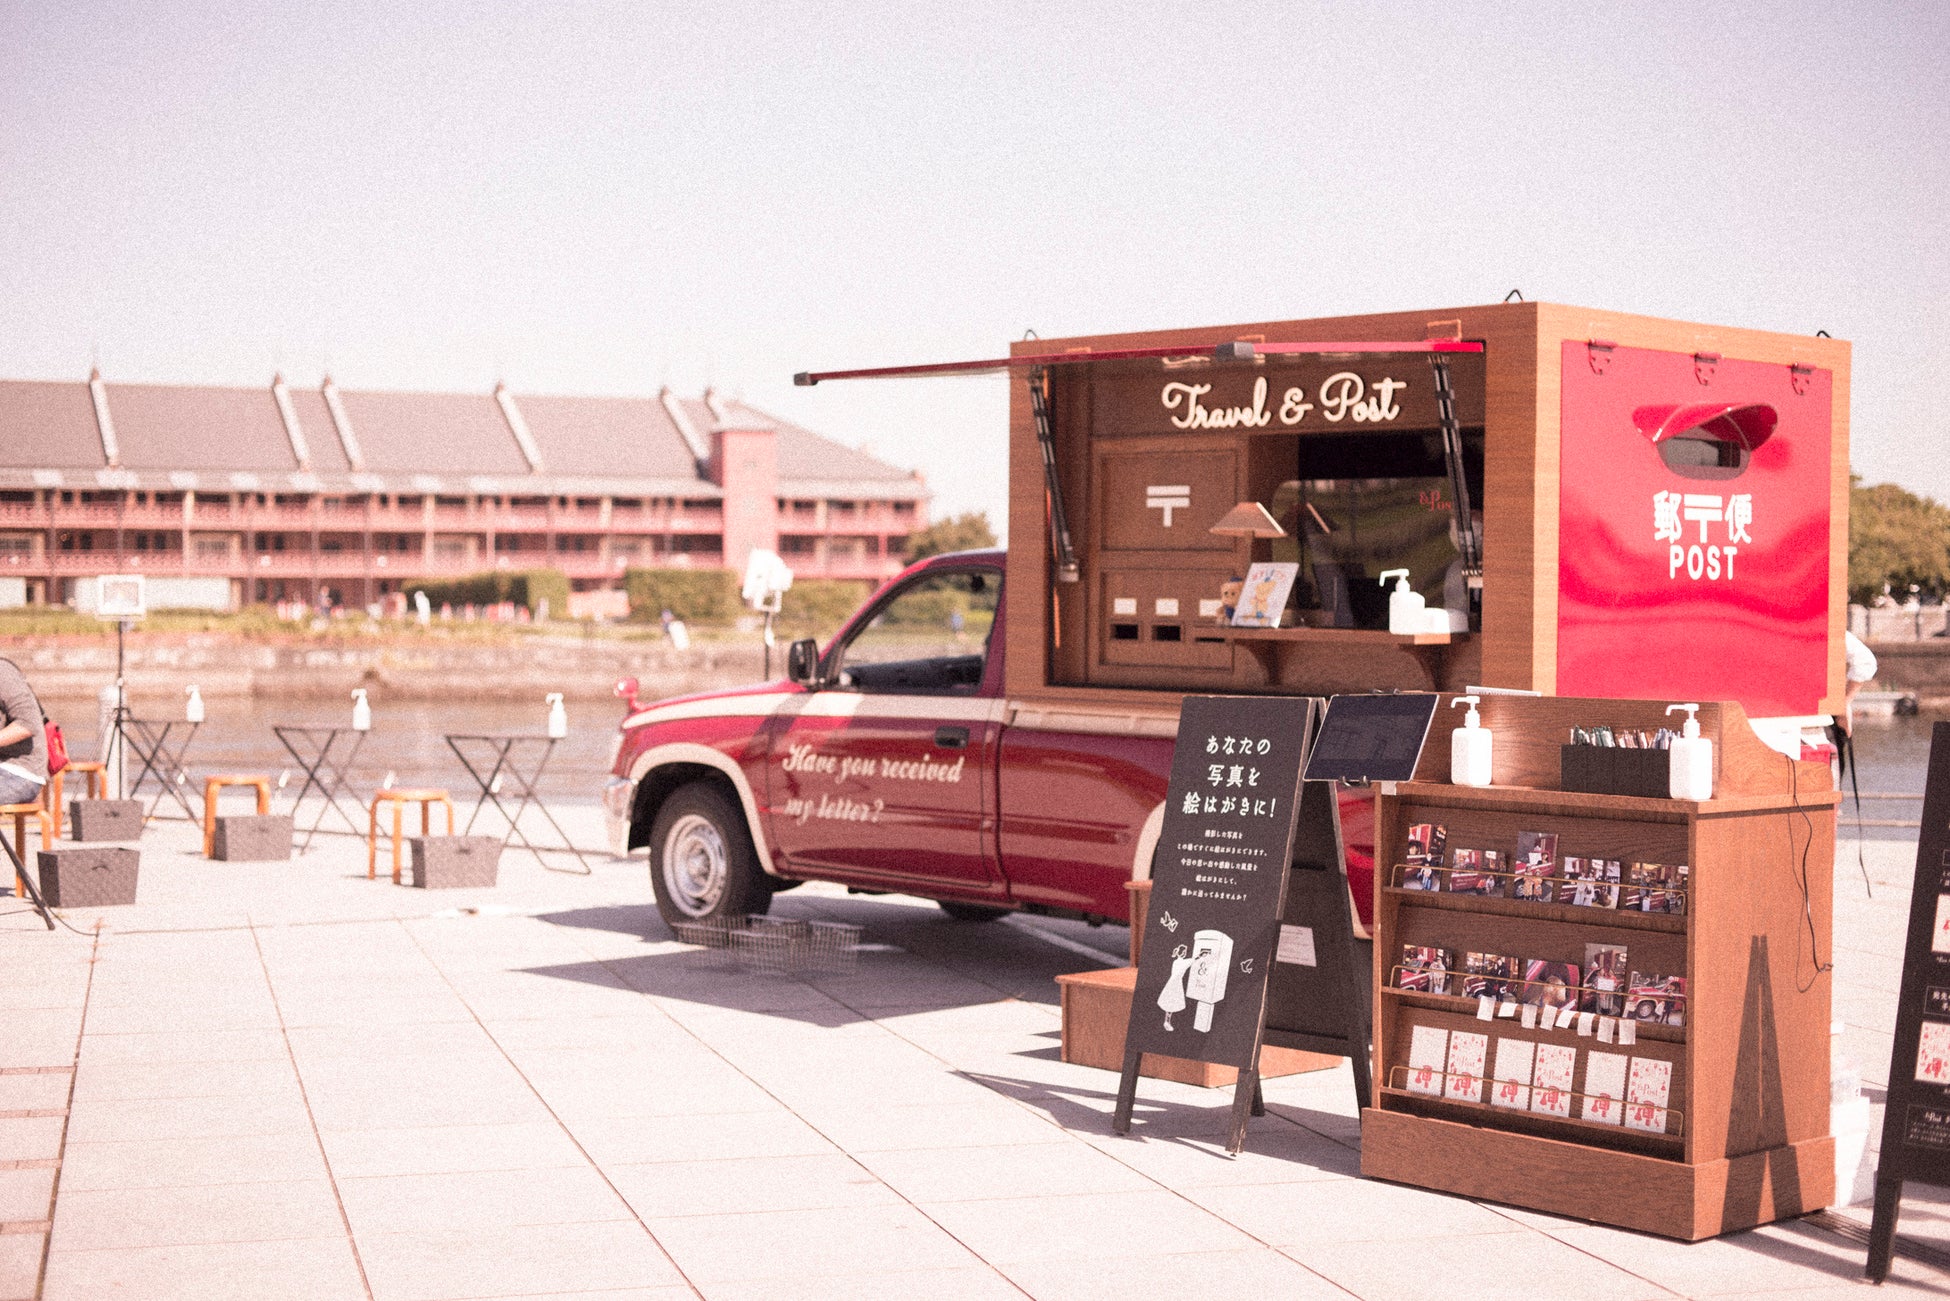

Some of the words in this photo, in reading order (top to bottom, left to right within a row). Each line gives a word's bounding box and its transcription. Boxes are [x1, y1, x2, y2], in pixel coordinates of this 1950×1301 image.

[1162, 377, 1271, 429] Travel
[1279, 387, 1314, 425] &
[1320, 371, 1408, 423] Post
[1669, 546, 1738, 580] POST
[1206, 735, 1271, 755] あなたの
[782, 743, 837, 774] Have
[835, 755, 876, 784] you
[881, 753, 966, 784] received
[1207, 764, 1261, 788] 写真を
[784, 797, 815, 826] my
[816, 793, 885, 824] letter?
